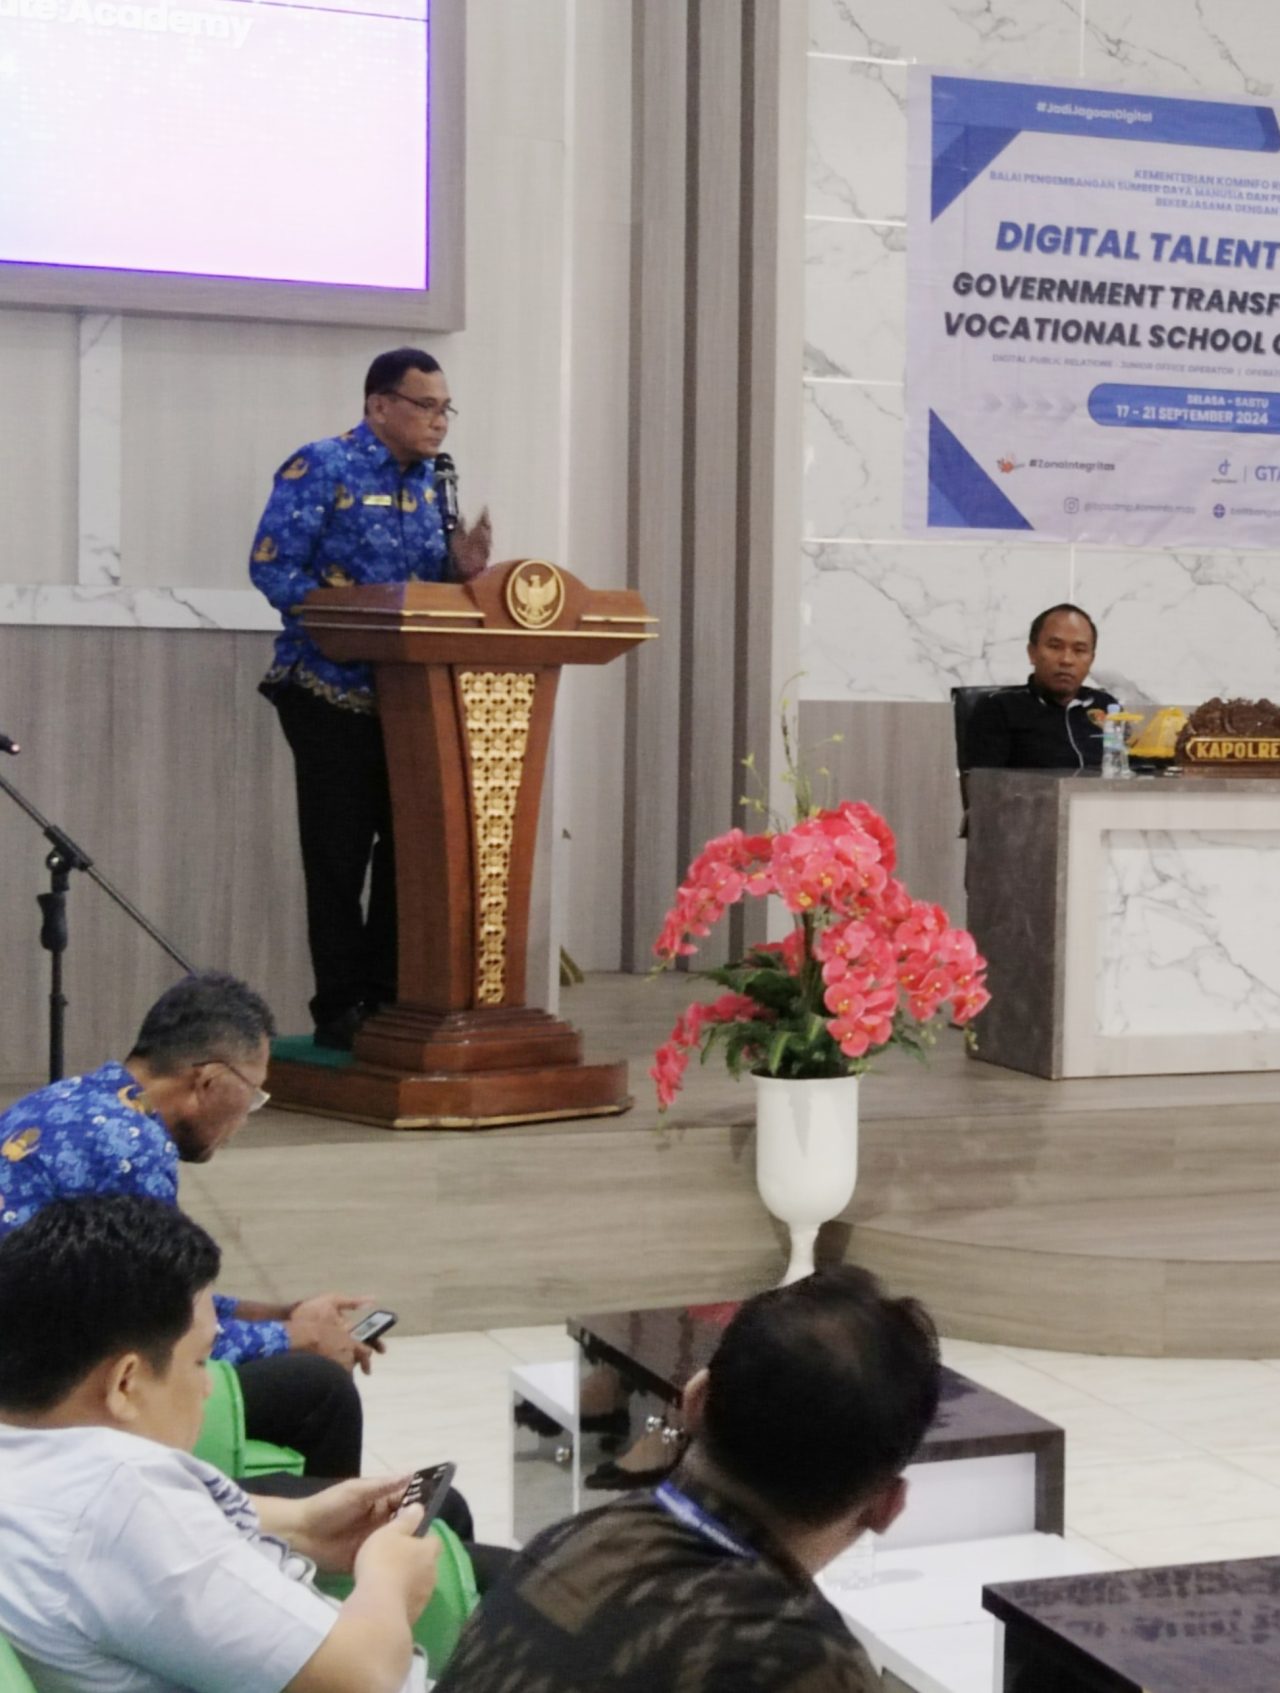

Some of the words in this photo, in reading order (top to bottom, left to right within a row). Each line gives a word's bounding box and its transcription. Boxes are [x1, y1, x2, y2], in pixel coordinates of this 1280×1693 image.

[57, 0, 253, 48] Academy
[1036, 101, 1153, 124] #JadiJagoanDigital
[989, 171, 1022, 183] BALAI
[1023, 174, 1115, 189] PENGEMBANGAN
[1118, 181, 1161, 193] SUMBER
[1163, 185, 1193, 196] DAYA
[1195, 188, 1244, 200] MANUSIA
[1246, 193, 1271, 202] DAN
[1134, 169, 1214, 186] KEMENTERIAN
[1216, 176, 1269, 190] KOMINFO
[1155, 197, 1232, 212] BEKERJASAMA
[1234, 204, 1279, 216] DENGAN
[995, 221, 1140, 260] DIGITAL
[952, 272, 1165, 308] GOVERNMENT
[944, 311, 1141, 347] VOCATIONAL
[1148, 324, 1266, 355] SCHOOL
[1115, 404, 1130, 418] 17
[1142, 406, 1156, 419] 21
[1158, 407, 1234, 424] SEPTEMBER
[1235, 411, 1269, 425] 2024
[1029, 458, 1116, 473] #ZonaIntegritas
